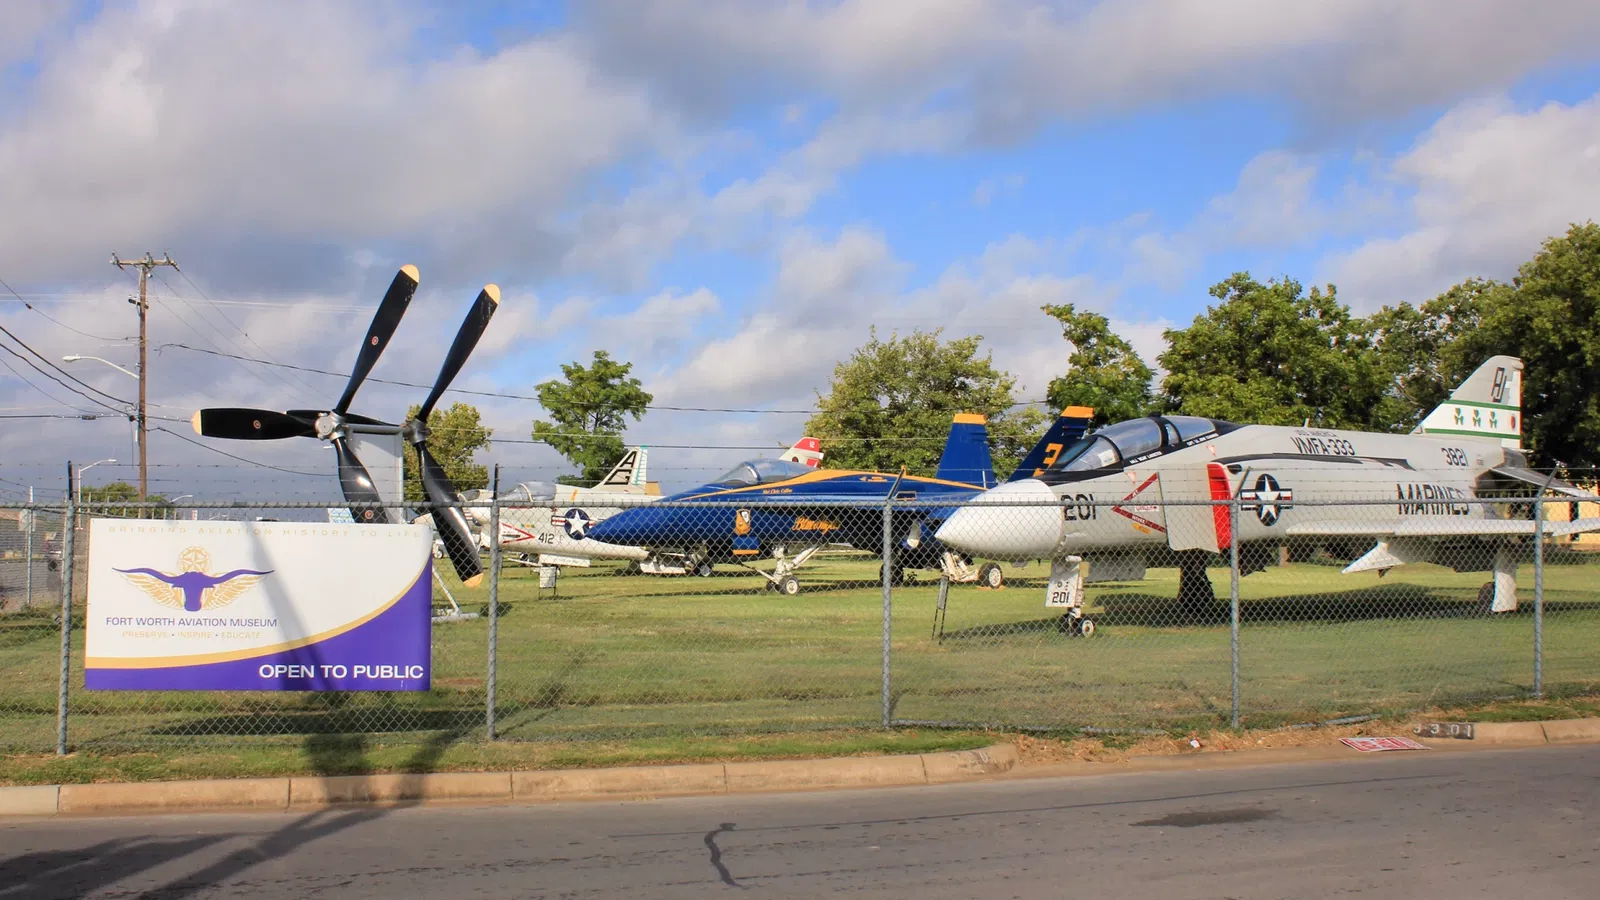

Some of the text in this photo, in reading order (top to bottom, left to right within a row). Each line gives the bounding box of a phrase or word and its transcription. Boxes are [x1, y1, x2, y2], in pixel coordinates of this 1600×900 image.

[1290, 437, 1355, 455] VMFA-333
[1441, 447, 1468, 467] 3821
[1061, 493, 1096, 520] 201
[1396, 483, 1470, 516] MARINES
[108, 526, 186, 534] BRINGING
[198, 527, 272, 536] AVIATION
[283, 529, 349, 537] HISTORY
[538, 532, 555, 544] 412
[1052, 591, 1070, 604] 201
[106, 617, 278, 627] FORT WORTH AVIATION MUSEUM
[177, 631, 212, 639] INSPIRE
[220, 631, 261, 639] EDUCATE
[258, 664, 424, 679] OPEN TO PUBLIC
